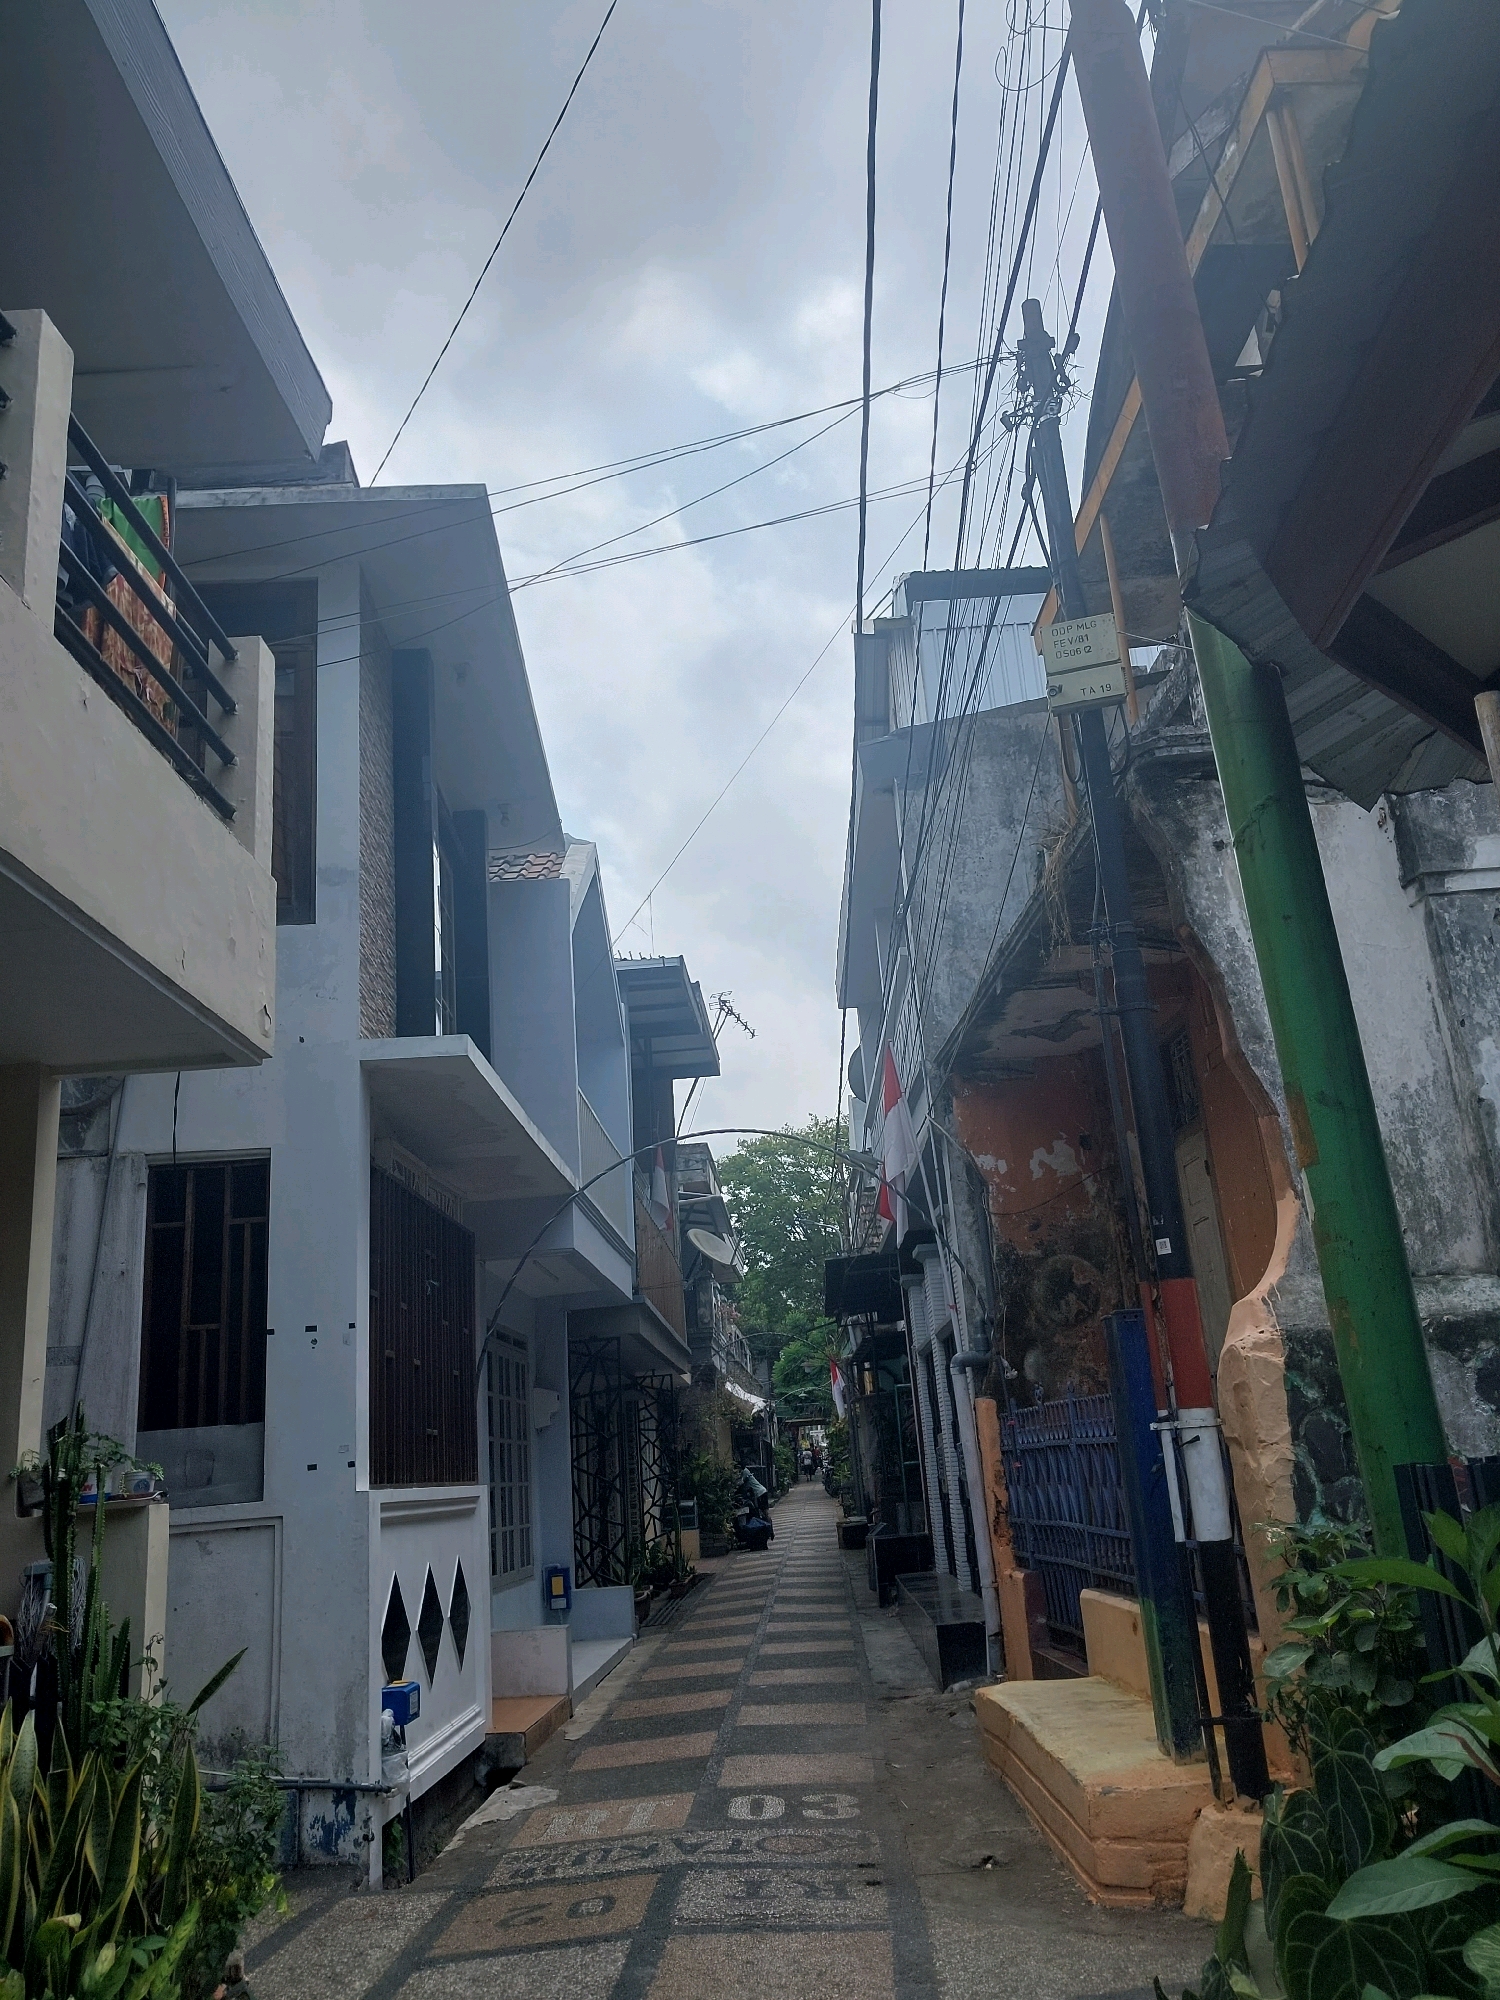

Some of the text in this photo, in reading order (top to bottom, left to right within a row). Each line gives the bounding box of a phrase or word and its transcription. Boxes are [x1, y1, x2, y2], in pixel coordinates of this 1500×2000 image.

[1051, 620, 1097, 637] ODP MLG
[1080, 683, 1112, 697] TA 19
[727, 1793, 861, 1821] 03
